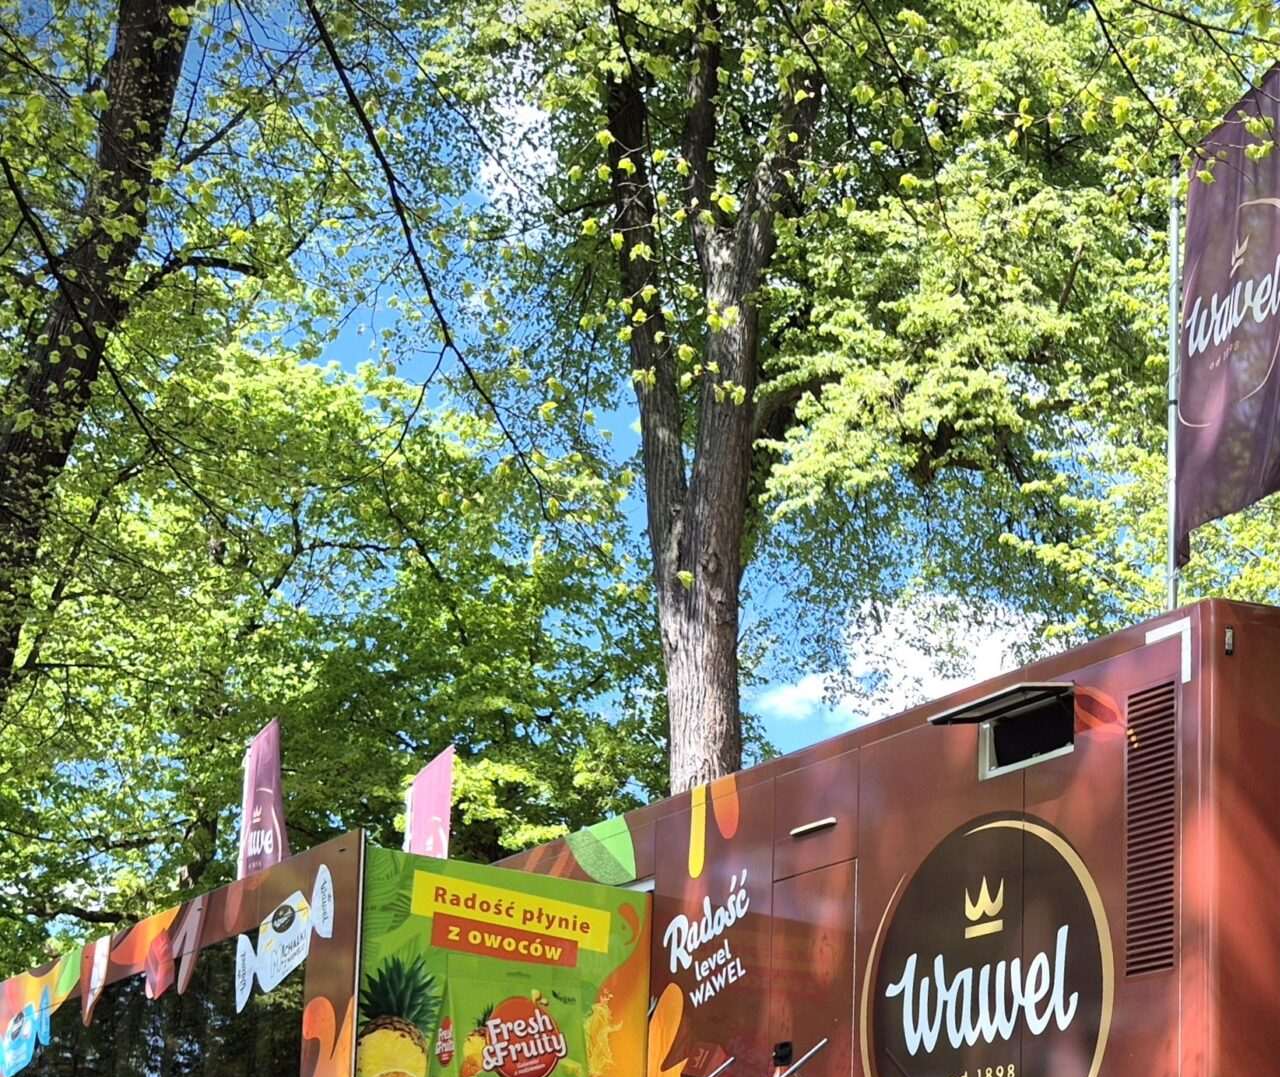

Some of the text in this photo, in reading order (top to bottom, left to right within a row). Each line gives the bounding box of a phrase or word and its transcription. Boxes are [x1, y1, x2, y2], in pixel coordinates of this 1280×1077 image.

[434, 886, 592, 934] Radość płynie
[663, 868, 750, 974] Radość
[447, 926, 562, 961] z owoców
[694, 938, 732, 982] level
[689, 957, 747, 1009] WAWEL
[885, 924, 1079, 1056] Wawel
[485, 1008, 553, 1046] Fresh
[482, 1032, 567, 1071] &Fruity
